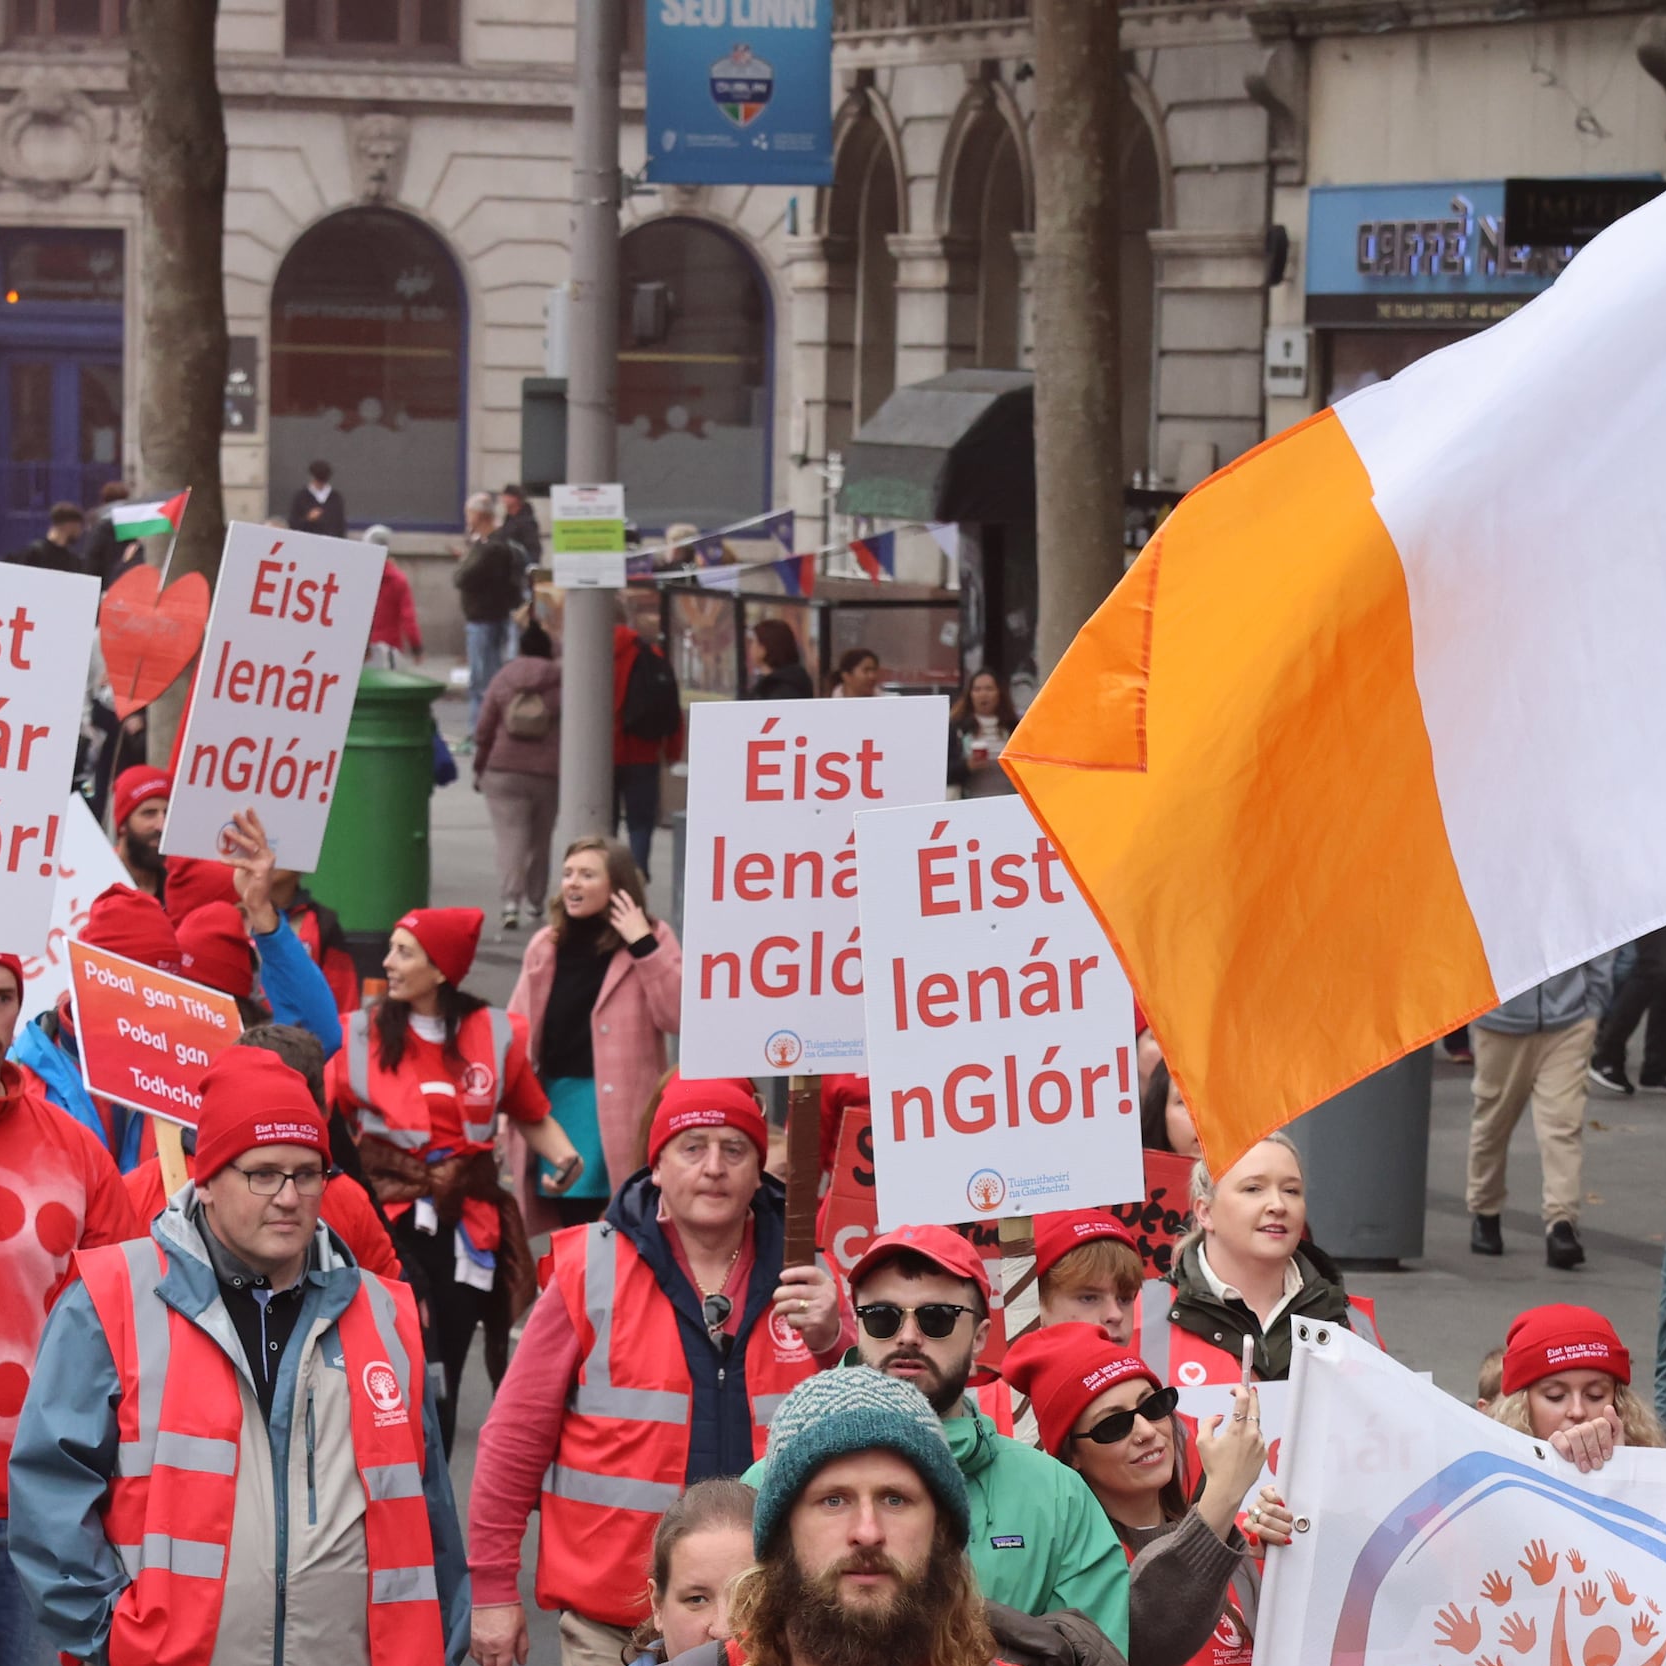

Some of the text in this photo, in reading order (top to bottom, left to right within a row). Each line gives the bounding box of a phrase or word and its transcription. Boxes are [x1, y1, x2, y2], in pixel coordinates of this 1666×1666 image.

[251, 541, 340, 628] Éist
[212, 640, 340, 715] lenár
[187, 735, 337, 804] nGlór!
[745, 717, 884, 802] Éist
[711, 830, 856, 902] lená
[918, 820, 1065, 917] Éist
[84, 960, 227, 1029] Pobal gan Tithe
[699, 928, 864, 1000] nGló
[893, 937, 1099, 1031] lenár
[116, 1017, 209, 1067] Pobal gan
[891, 1045, 1133, 1142] nGlór!
